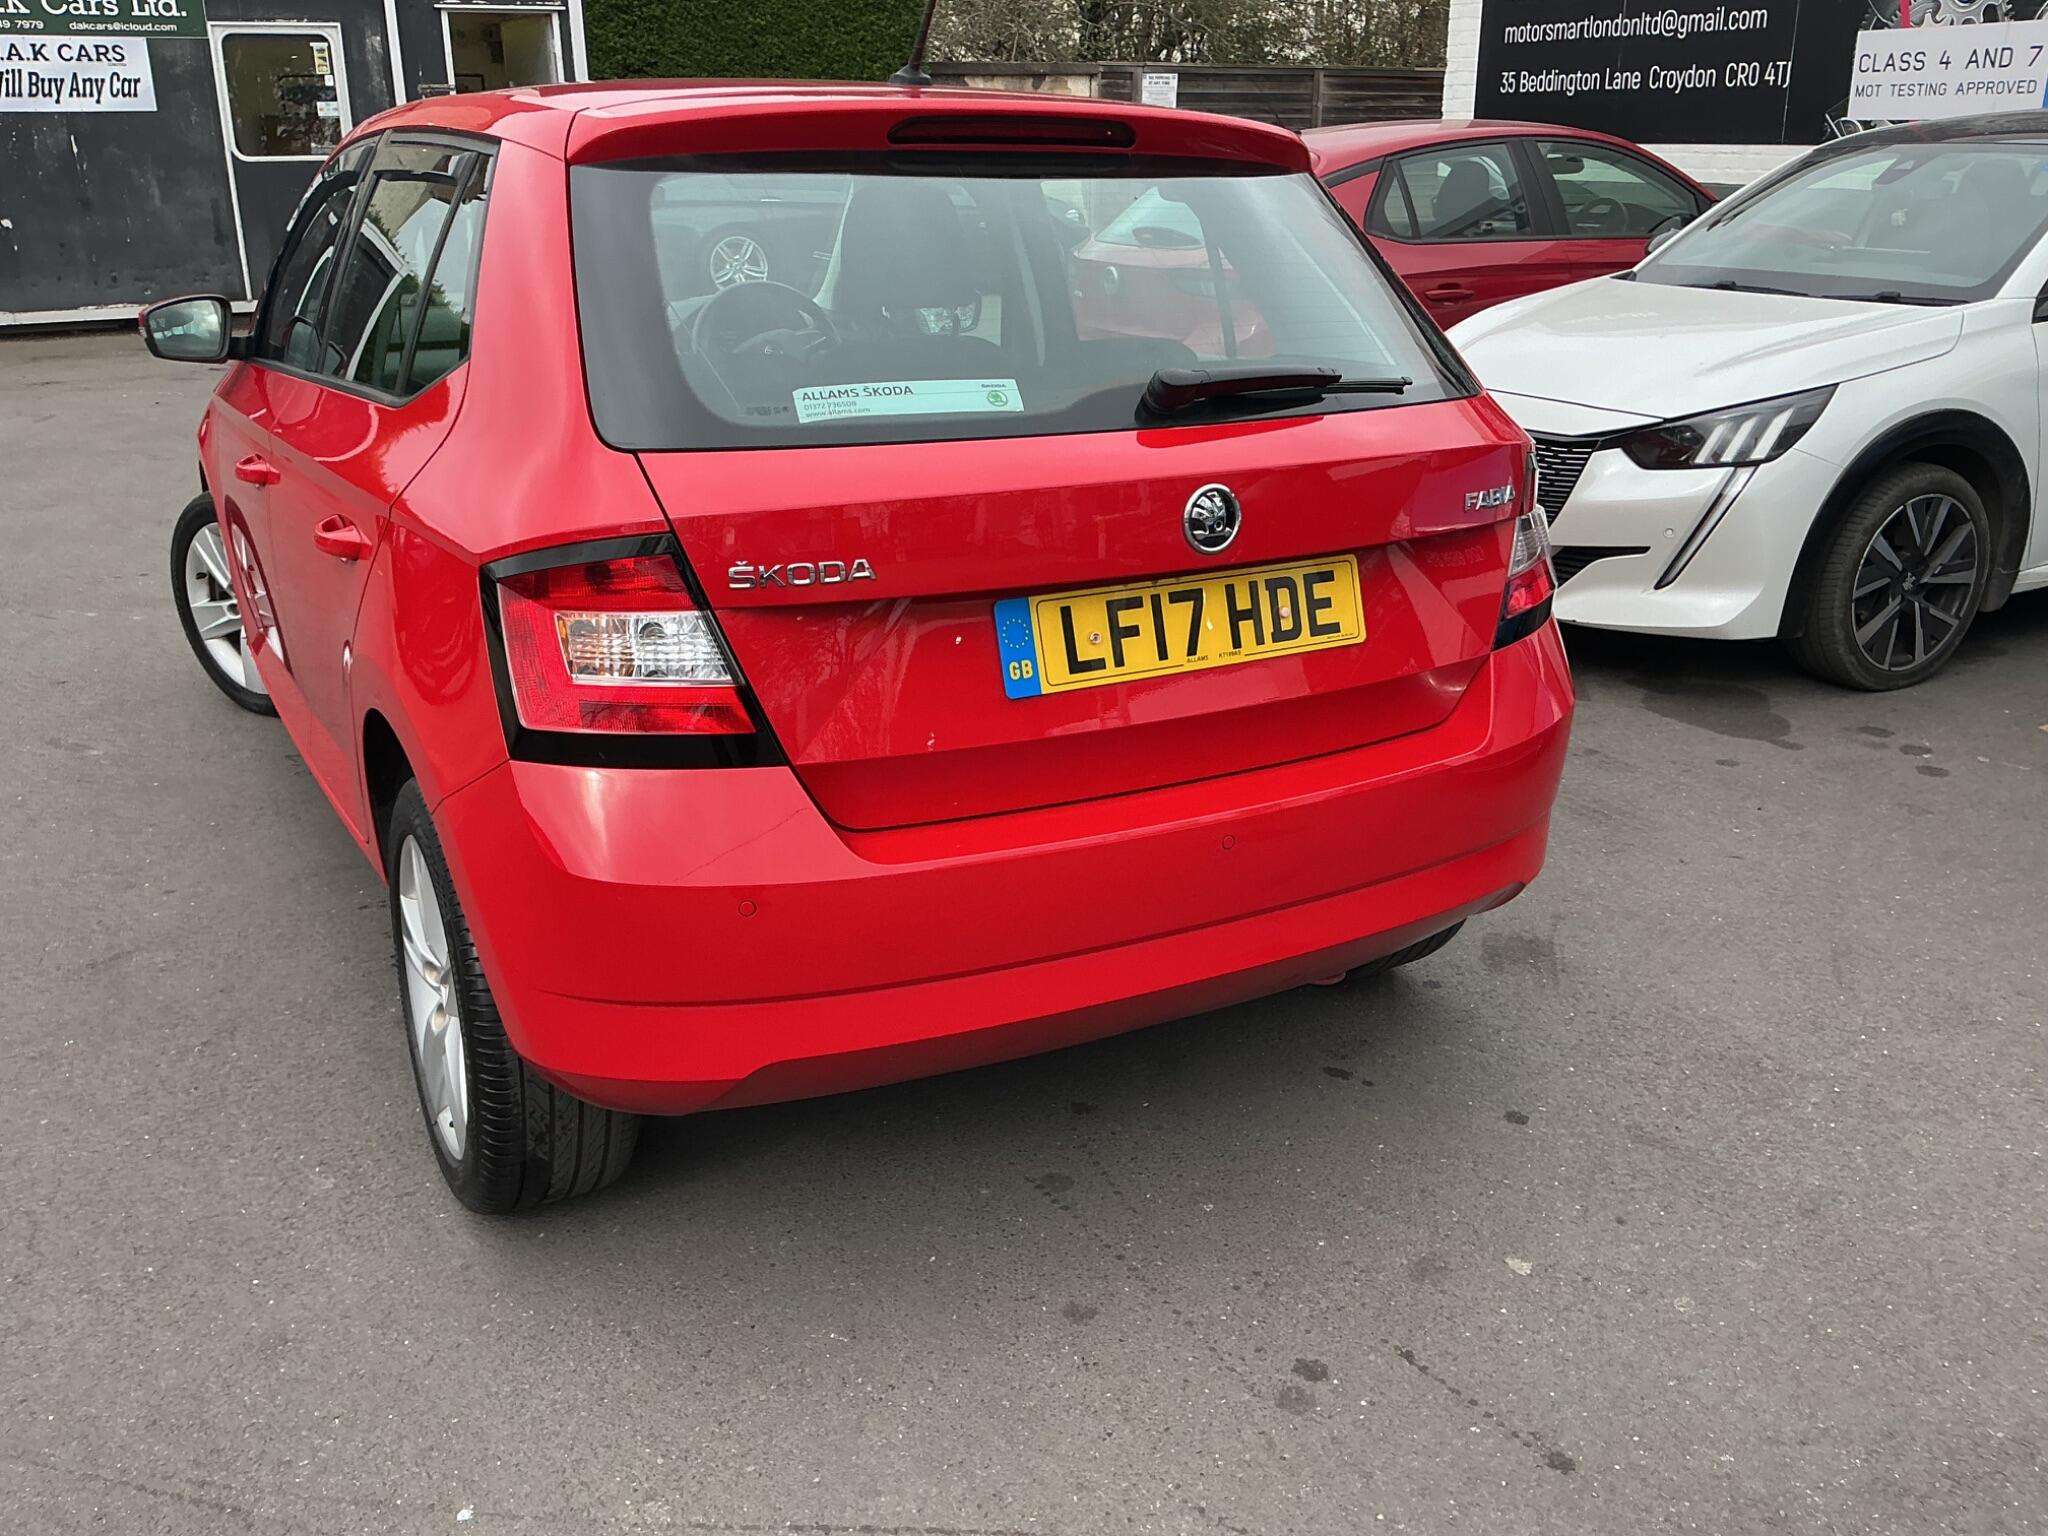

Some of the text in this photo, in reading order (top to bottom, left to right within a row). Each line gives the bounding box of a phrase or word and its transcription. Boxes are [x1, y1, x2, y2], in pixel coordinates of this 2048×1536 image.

[41, 0, 119, 17] Cars
[131, 0, 188, 17] Ltd.
[15, 20, 44, 30] 7979
[69, 21, 178, 31] dakcars@icloud.com
[1504, 7, 1768, 44] motorsmartlondonltd@gmail.com
[57, 44, 126, 62] CARS
[1858, 45, 2044, 73] CLASS 4 AND 7
[28, 71, 65, 104] Buy
[69, 72, 105, 104] Any
[109, 71, 141, 98] Car
[1500, 72, 1516, 93] 35
[1520, 69, 1600, 96] Beddington
[1605, 68, 1641, 90] Lane
[1649, 64, 1716, 94] Croydon
[1764, 61, 1792, 88] 4TJ
[1855, 79, 2037, 98] MOT TESTING APPROVED
[802, 385, 914, 401] ALLAMS ŠKODA
[1465, 485, 1516, 511] FABIA
[728, 559, 877, 589] ŠKODA
[1060, 570, 1341, 675] LF17 HDE
[1186, 655, 1208, 663] ALLAMS
[1009, 660, 1032, 681] GB
